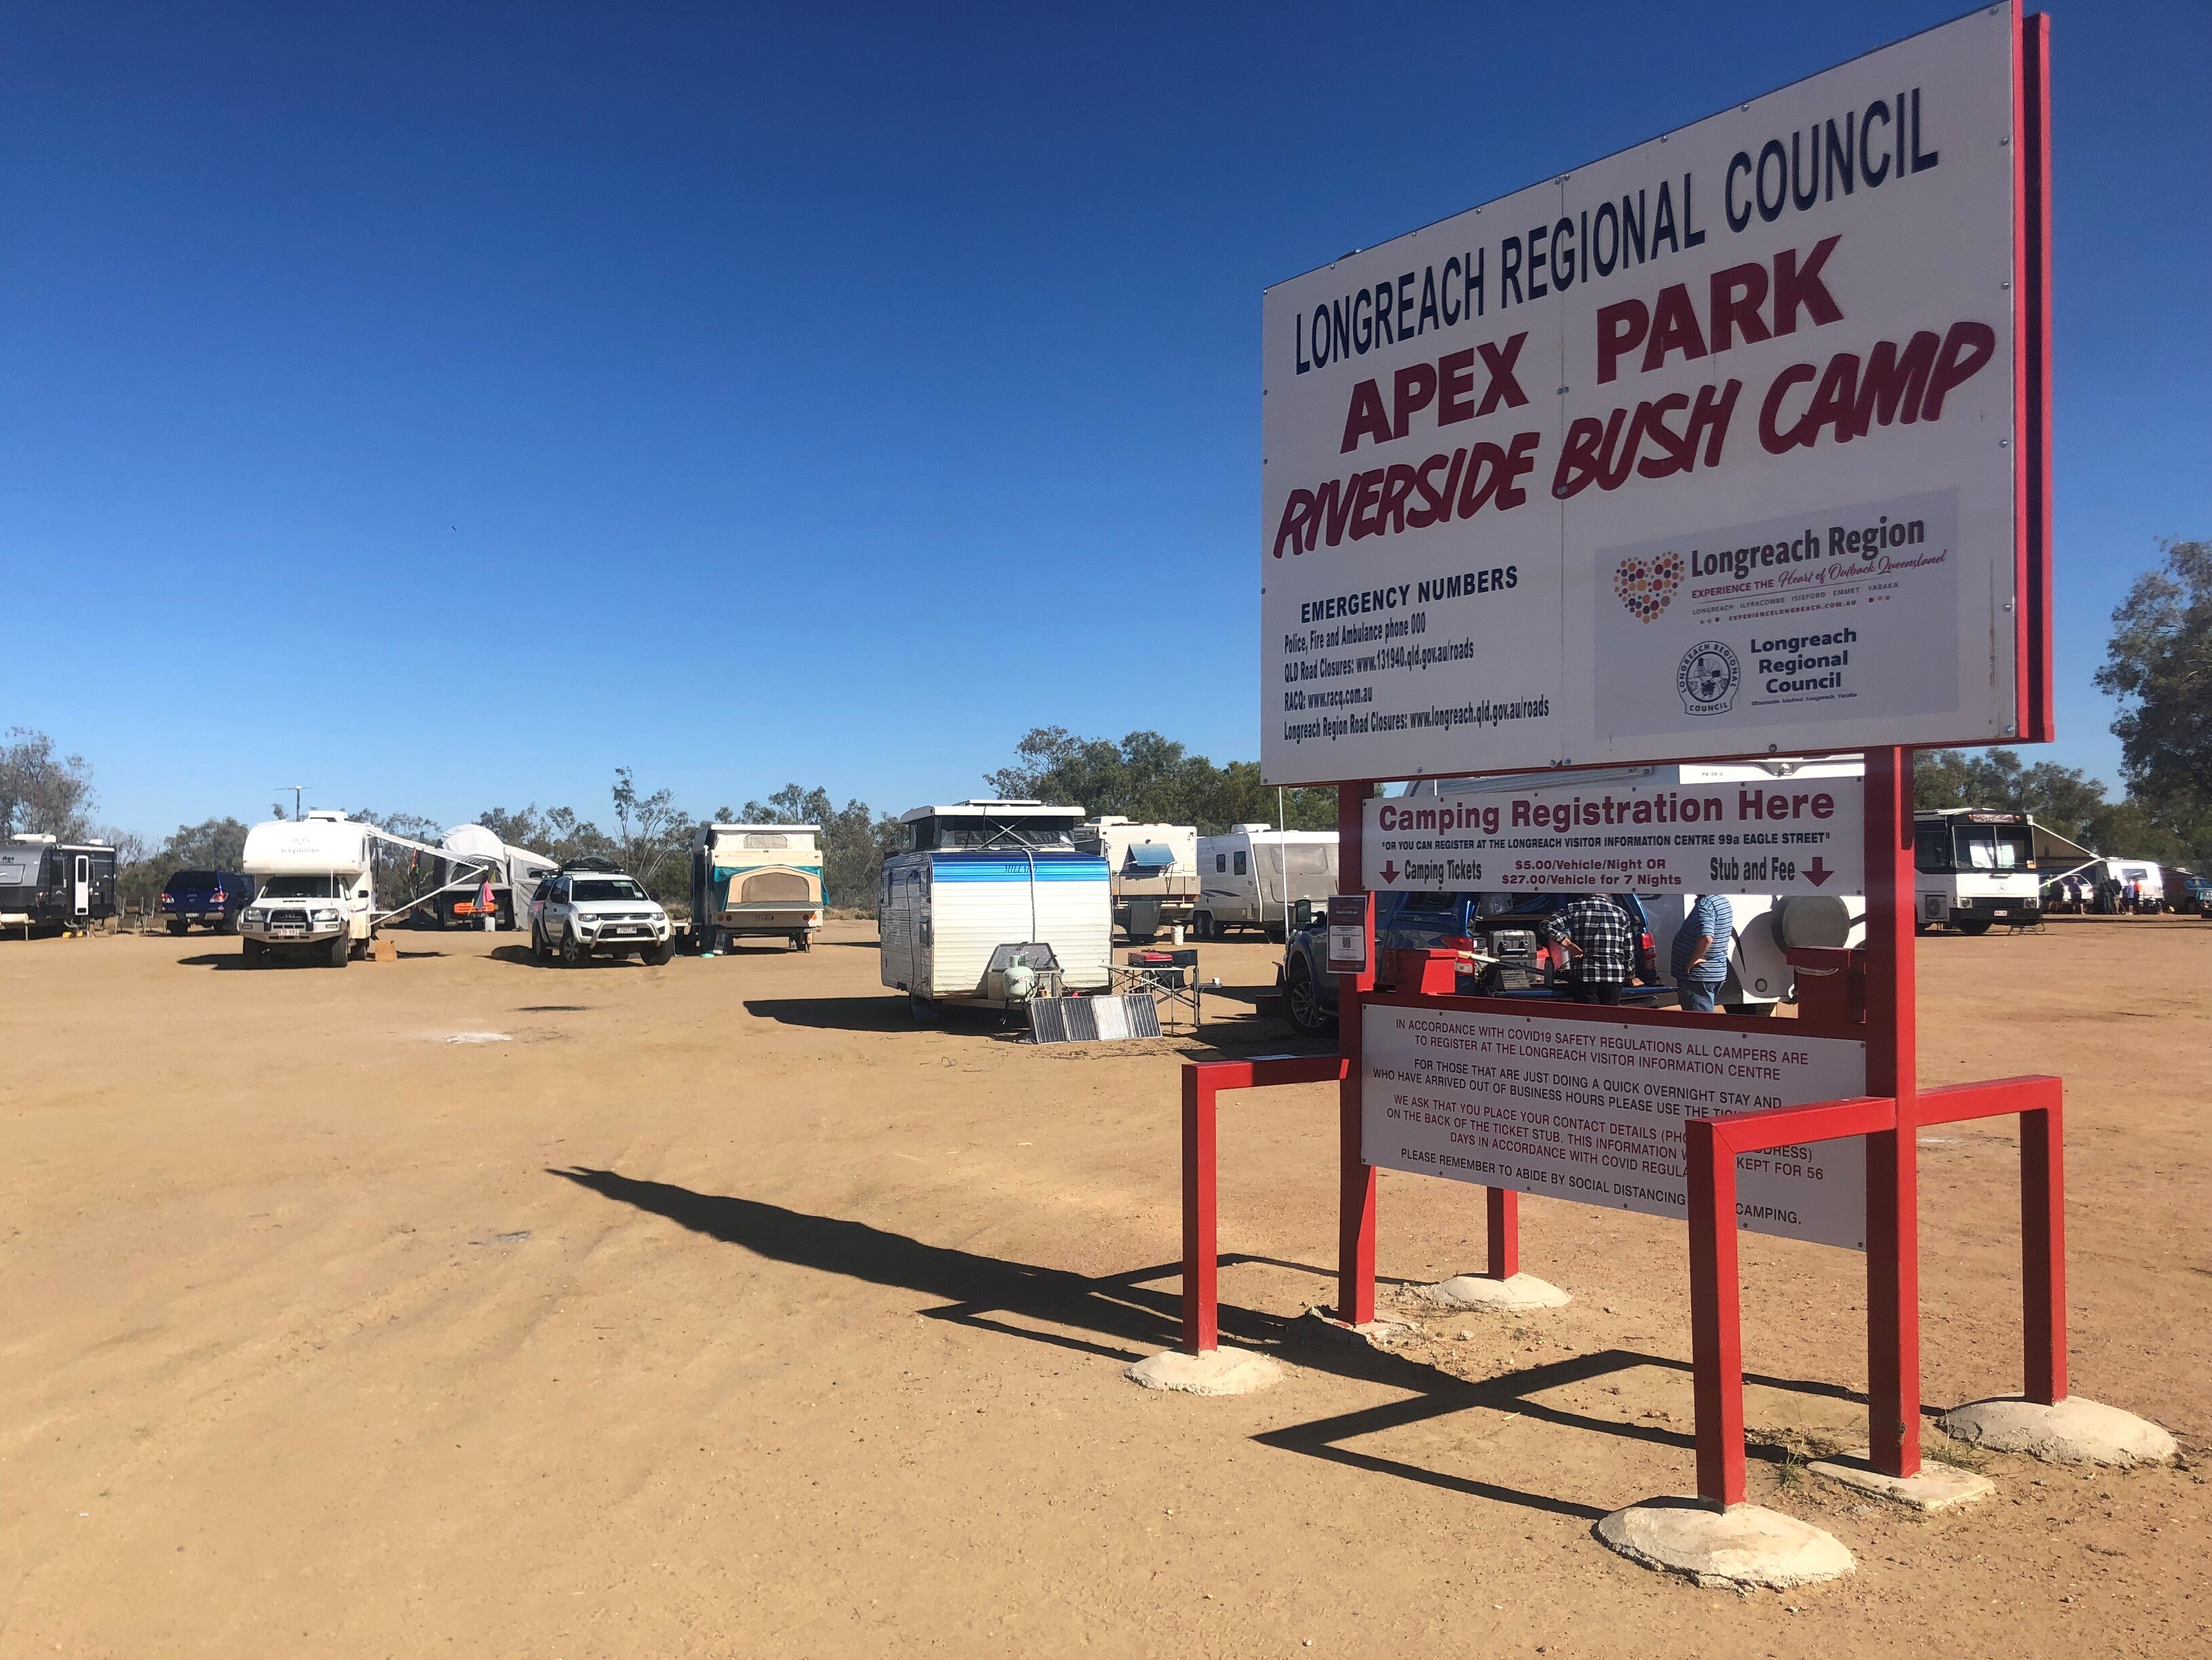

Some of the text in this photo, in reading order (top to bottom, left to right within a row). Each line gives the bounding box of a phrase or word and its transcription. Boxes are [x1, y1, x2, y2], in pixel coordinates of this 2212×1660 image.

[1297, 88, 1939, 375] LONGREACH REGIONAL COUNCIL
[1340, 234, 1844, 454] APEX PARK
[1273, 322, 1996, 559] RIVERSIDE BUSH CAMP
[1692, 516, 1924, 580] Longreach Region
[1301, 565, 1518, 624] EMERGENCY NUMBERS
[1692, 548, 1947, 599] EXPERIENCE THE Heart of Outback Queensland
[1692, 582, 1900, 616] LONGREACH ILFRACOMBE ISISFORD EMMET YARAKA
[1728, 599, 1856, 622] EXPERIENCELONGREACH.COM.AU
[1285, 611, 1426, 656] Police, Fire and Ambulance phone 000
[1750, 627, 1857, 654] Longreach
[1284, 637, 1474, 683] QLD Road Closures: www.131940.qld.gov.au/roads
[1679, 643, 1738, 713] LONGREACH REGIONAL COUNCIL
[1759, 649, 1848, 676] Regional
[1766, 671, 1842, 694] Council
[1284, 686, 1373, 712] RACQ: www.racq.com.au
[1284, 694, 1549, 745] Longreach Region Road Closures: www.longreach.qld.gov.au/roads
[1379, 789, 1835, 836] Camping Registration Here
[1398, 840, 1414, 850] YOU
[1415, 840, 1432, 850] CAN
[1434, 840, 1474, 850] REGISTER
[1476, 839, 1487, 849] AT
[1488, 839, 1506, 849] THE
[1508, 837, 1562, 849] LONGREACH
[1564, 837, 1601, 848] VISITOR
[1604, 835, 1671, 847] INFORMATION
[1674, 834, 1715, 846] CENTRE
[1718, 834, 1740, 845] 99a
[1743, 833, 1778, 845] EAGLE
[1781, 832, 1830, 844] STREET"
[1405, 859, 1482, 885] Camping Tickets
[1502, 873, 1682, 888] $27.00/Vehicle for 7 Nights
[1515, 859, 1666, 872] $5.00/Vehicle/Night OR
[1710, 856, 1795, 882] Stub and Fee
[1396, 1019, 1809, 1065] IN ACCORDANCE WITH COVID19 SAFETY REGULATIONS ALL CAMPERS ARE
[1414, 1034, 1780, 1080] TO REGISTER AT THE LONGREACH VISITOR INFORMATION CENTRE
[1373, 1068, 1395, 1080] WHO
[1398, 1070, 1422, 1084] HAVE
[1424, 1074, 1466, 1089] ARRIVED
[1469, 1079, 1490, 1092] OUT
[1492, 1082, 1506, 1094] OF
[1510, 1084, 1562, 1101] BUSINESS
[1565, 1091, 1605, 1107] HOURS
[1608, 1096, 1653, 1112] PLEASE
[1657, 1101, 1680, 1116] USE
[1683, 1105, 1710, 1119] THE
[1414, 1058, 1782, 1109] FOR THOSE THAT ARE JUST DOING A QUICK OVERNIGHT STAY AND
[1394, 1094, 1409, 1106] WE
[1411, 1096, 1430, 1109] ASK
[1432, 1099, 1457, 1112] THAT
[1460, 1103, 1481, 1116] YOU
[1483, 1106, 1517, 1121] PLACE
[1520, 1111, 1550, 1126] YOUR
[1552, 1115, 1606, 1133] CONTACT
[1609, 1123, 1657, 1140] DETAILS
[1662, 1130, 1686, 1144] (PH
[1386, 1108, 1400, 1119] ON
[1403, 1110, 1422, 1123] THE
[1424, 1113, 1451, 1127] BACK
[1453, 1117, 1467, 1129] OF
[1470, 1119, 1490, 1133] THE
[1492, 1123, 1529, 1138] TICKET
[1532, 1128, 1563, 1144] STUB.
[1567, 1133, 1593, 1148] THIS
[1596, 1137, 1677, 1160] INFORMATION
[1736, 1156, 1770, 1173] KEPT
[1774, 1162, 1801, 1177] FOR
[1806, 1167, 1824, 1180] 56
[1450, 1132, 1687, 1177] DAYS IN ACCORDANCE WITH COVID REGULA
[1401, 1148, 1801, 1225] PLEASE REMEMBER TO ABIDE BY SOCIAL DISTANCING CAMPING.
